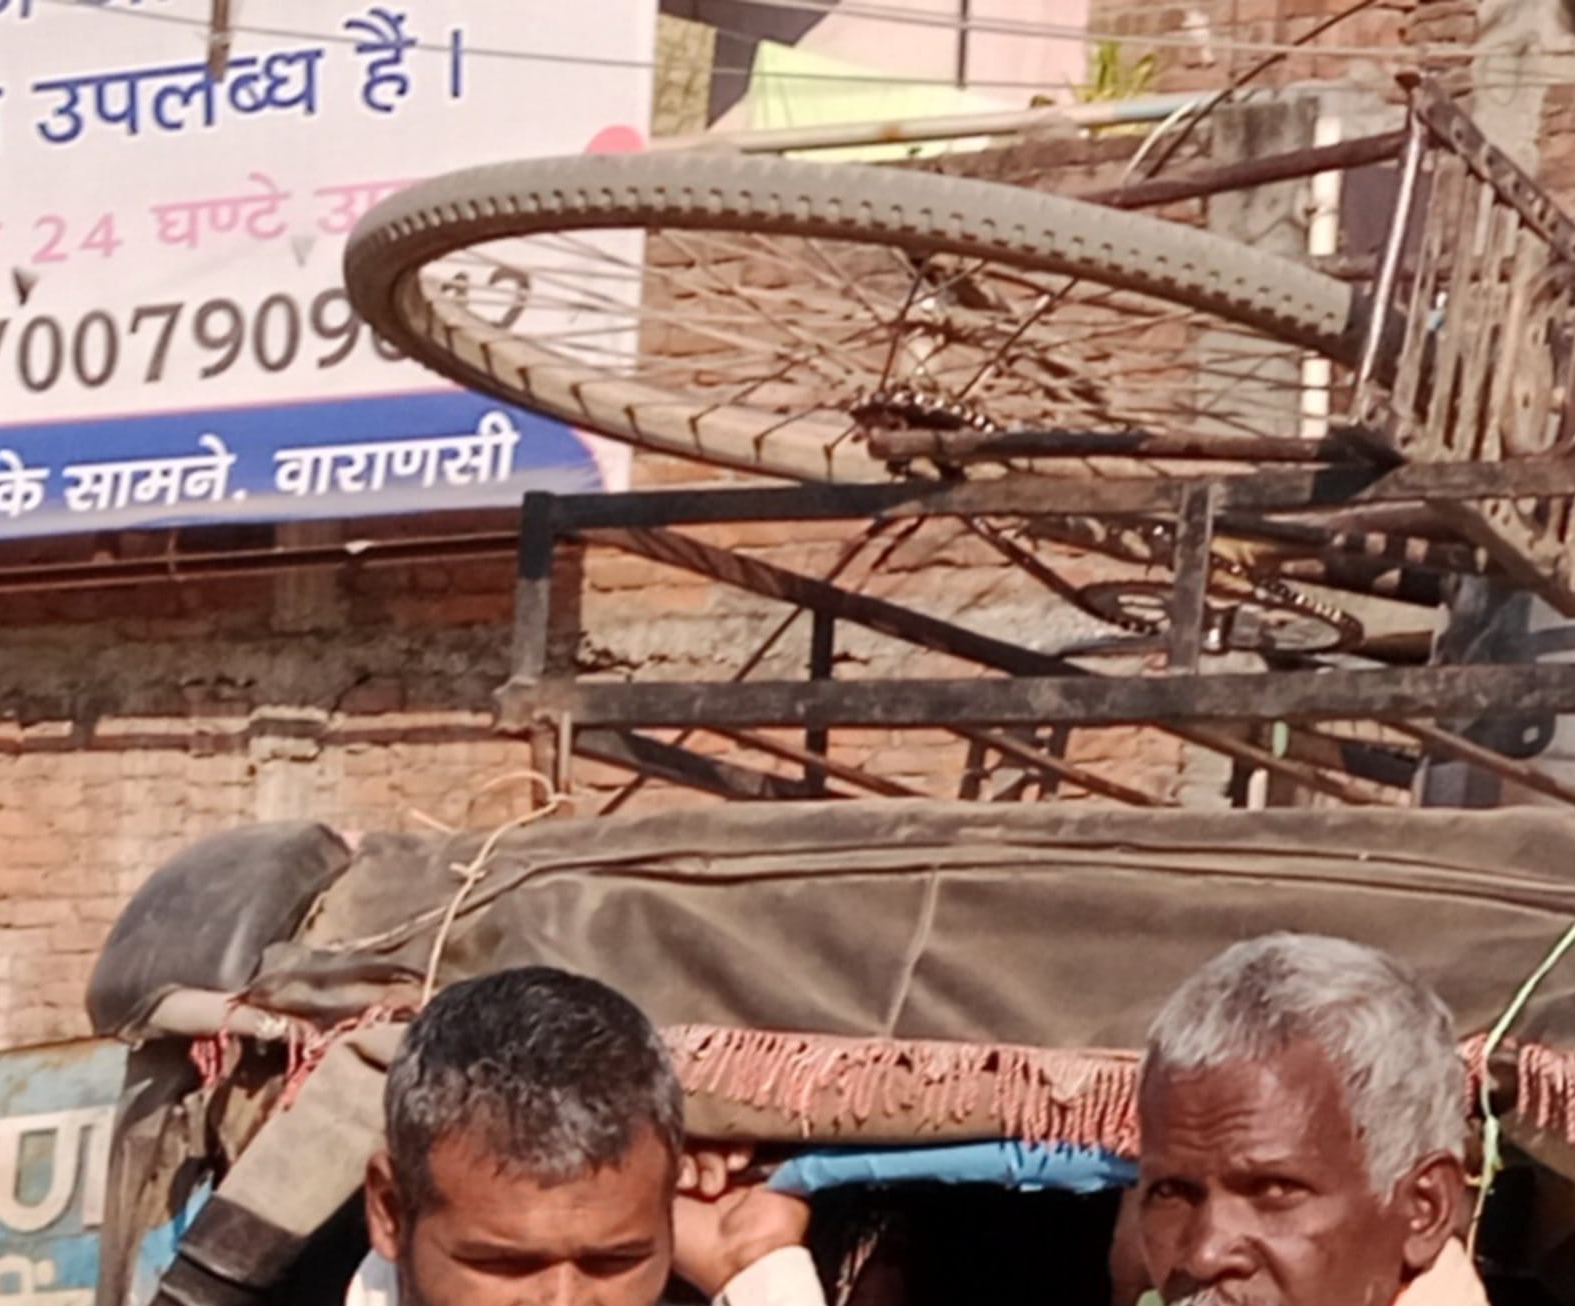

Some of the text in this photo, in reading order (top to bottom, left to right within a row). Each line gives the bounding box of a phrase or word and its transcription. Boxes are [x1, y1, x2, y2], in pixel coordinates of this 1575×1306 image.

[35, 45, 324, 144] उपलब्ध
[29, 210, 127, 266] 24
[151, 171, 291, 244] घण्टे
[272, 411, 520, 496] वाराणसी
